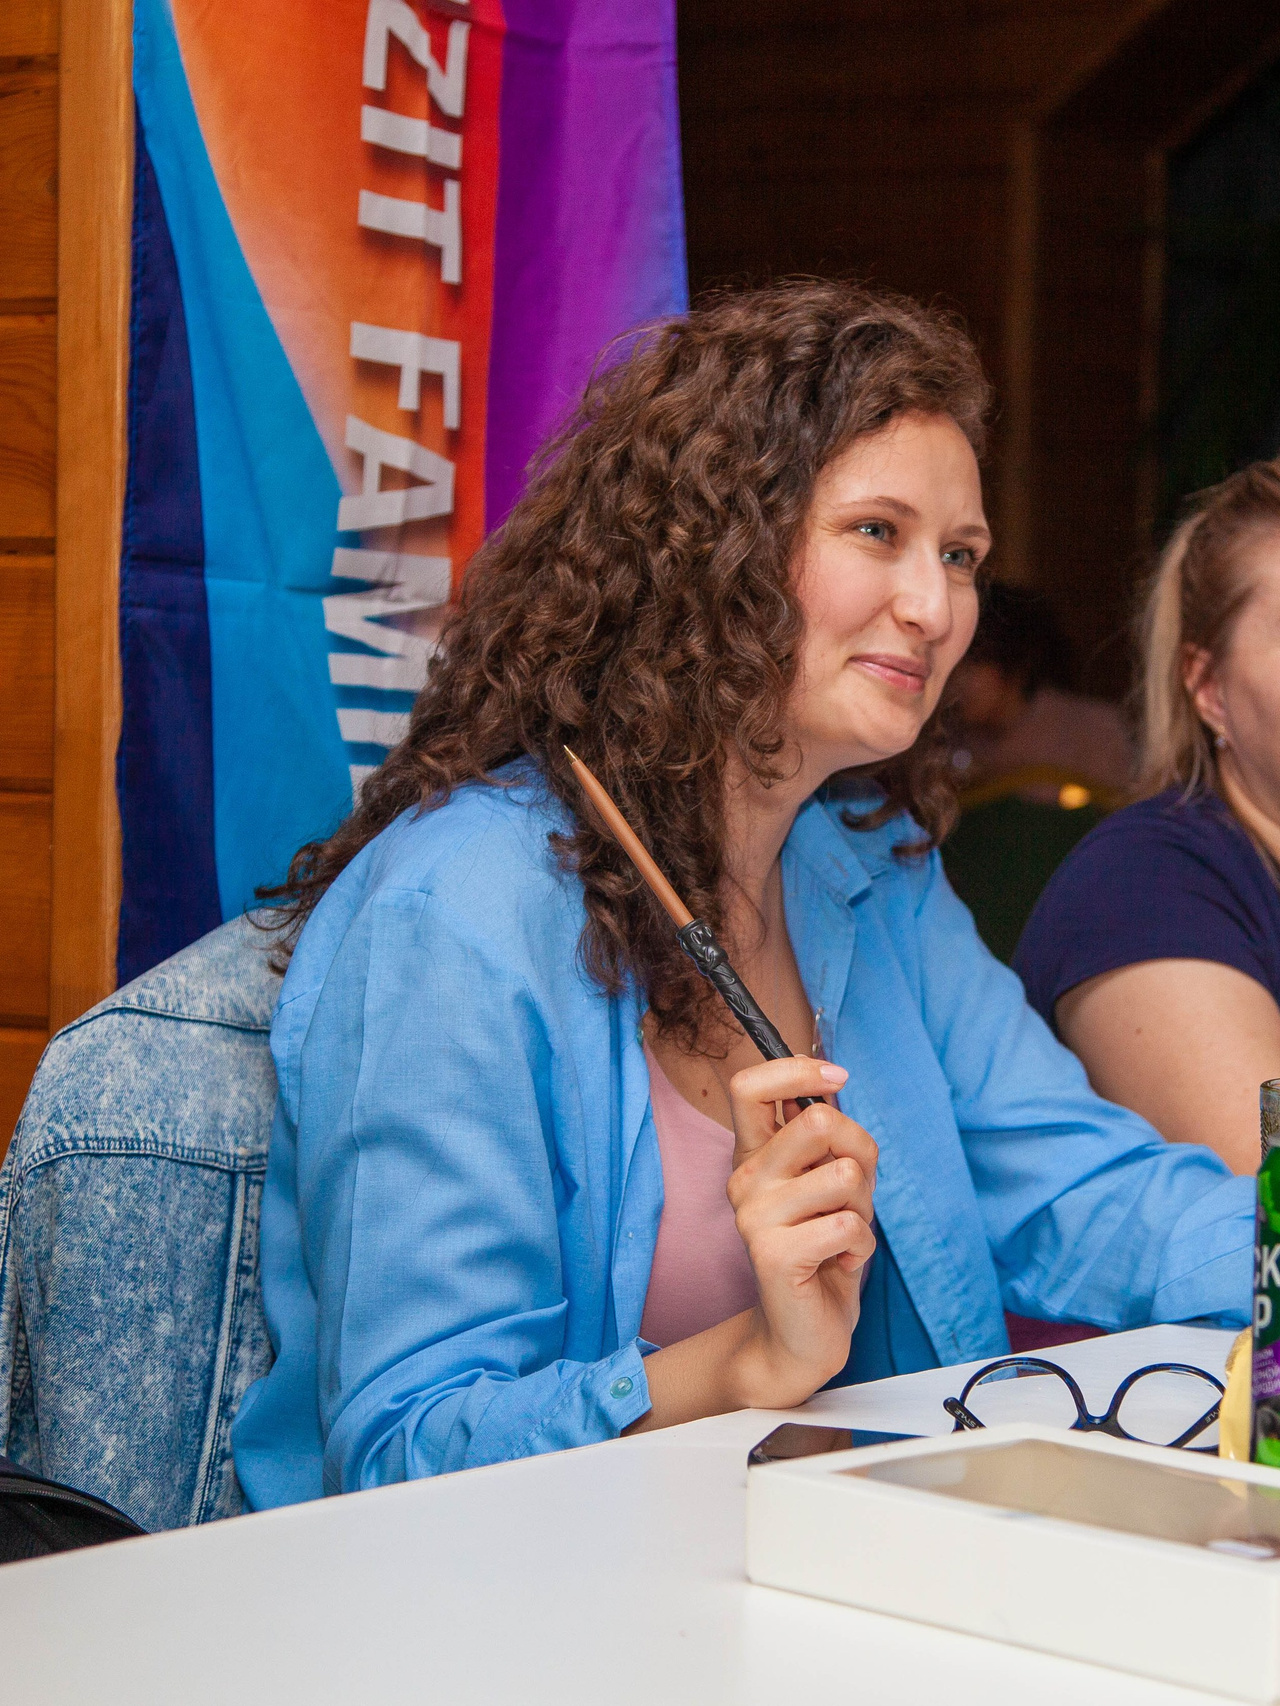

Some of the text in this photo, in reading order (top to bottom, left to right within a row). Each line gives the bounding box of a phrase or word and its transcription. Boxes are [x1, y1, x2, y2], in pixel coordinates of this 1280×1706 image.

[322, 0, 471, 815] ZIT FAMI
[955, 1408, 976, 1428] STYLE
